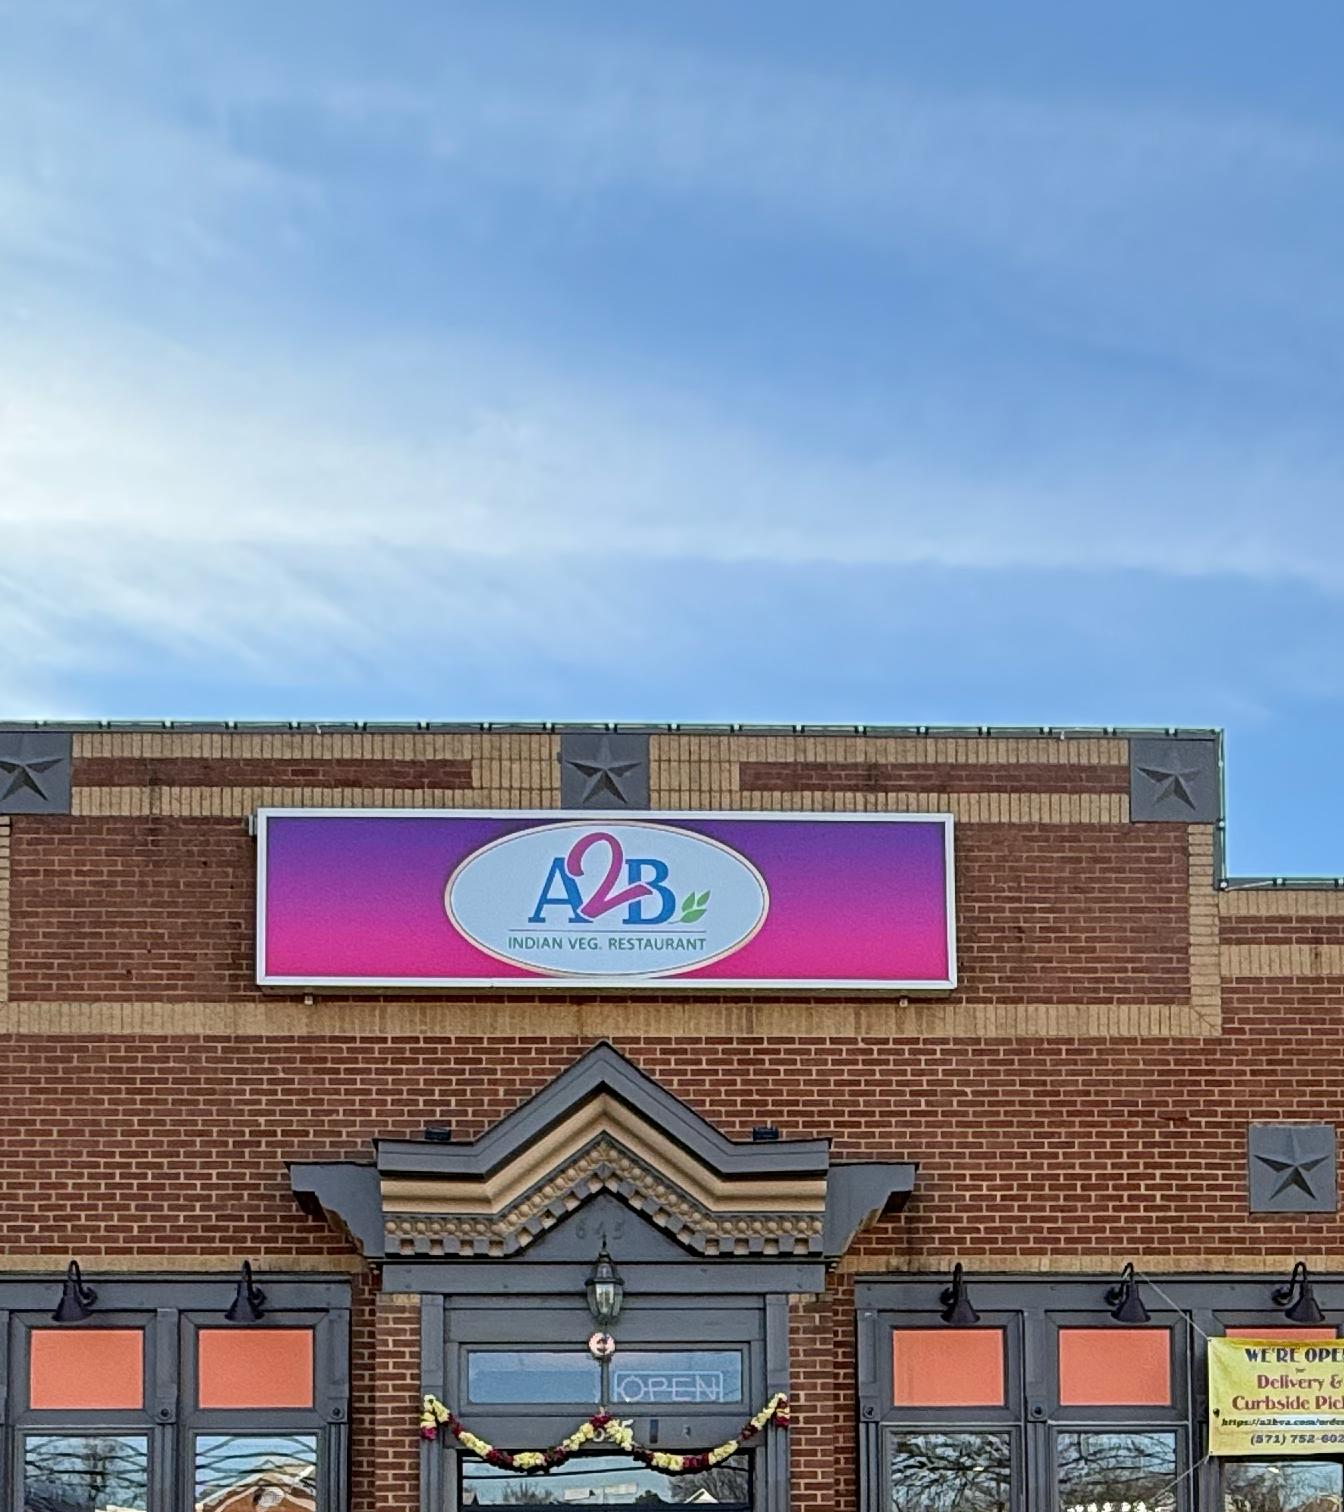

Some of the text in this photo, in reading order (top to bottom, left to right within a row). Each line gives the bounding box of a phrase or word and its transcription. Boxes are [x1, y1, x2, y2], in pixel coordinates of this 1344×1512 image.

[528, 832, 676, 924] A2B
[508, 937, 707, 951] INDIAN VEG. RESTAURANT
[1244, 1347, 1301, 1363] WE'RE
[621, 1375, 717, 1402] OPEN
[1257, 1374, 1344, 1391] Delivery &
[1232, 1395, 1311, 1411] Curbside
[1250, 1433, 1287, 1446] (571)
